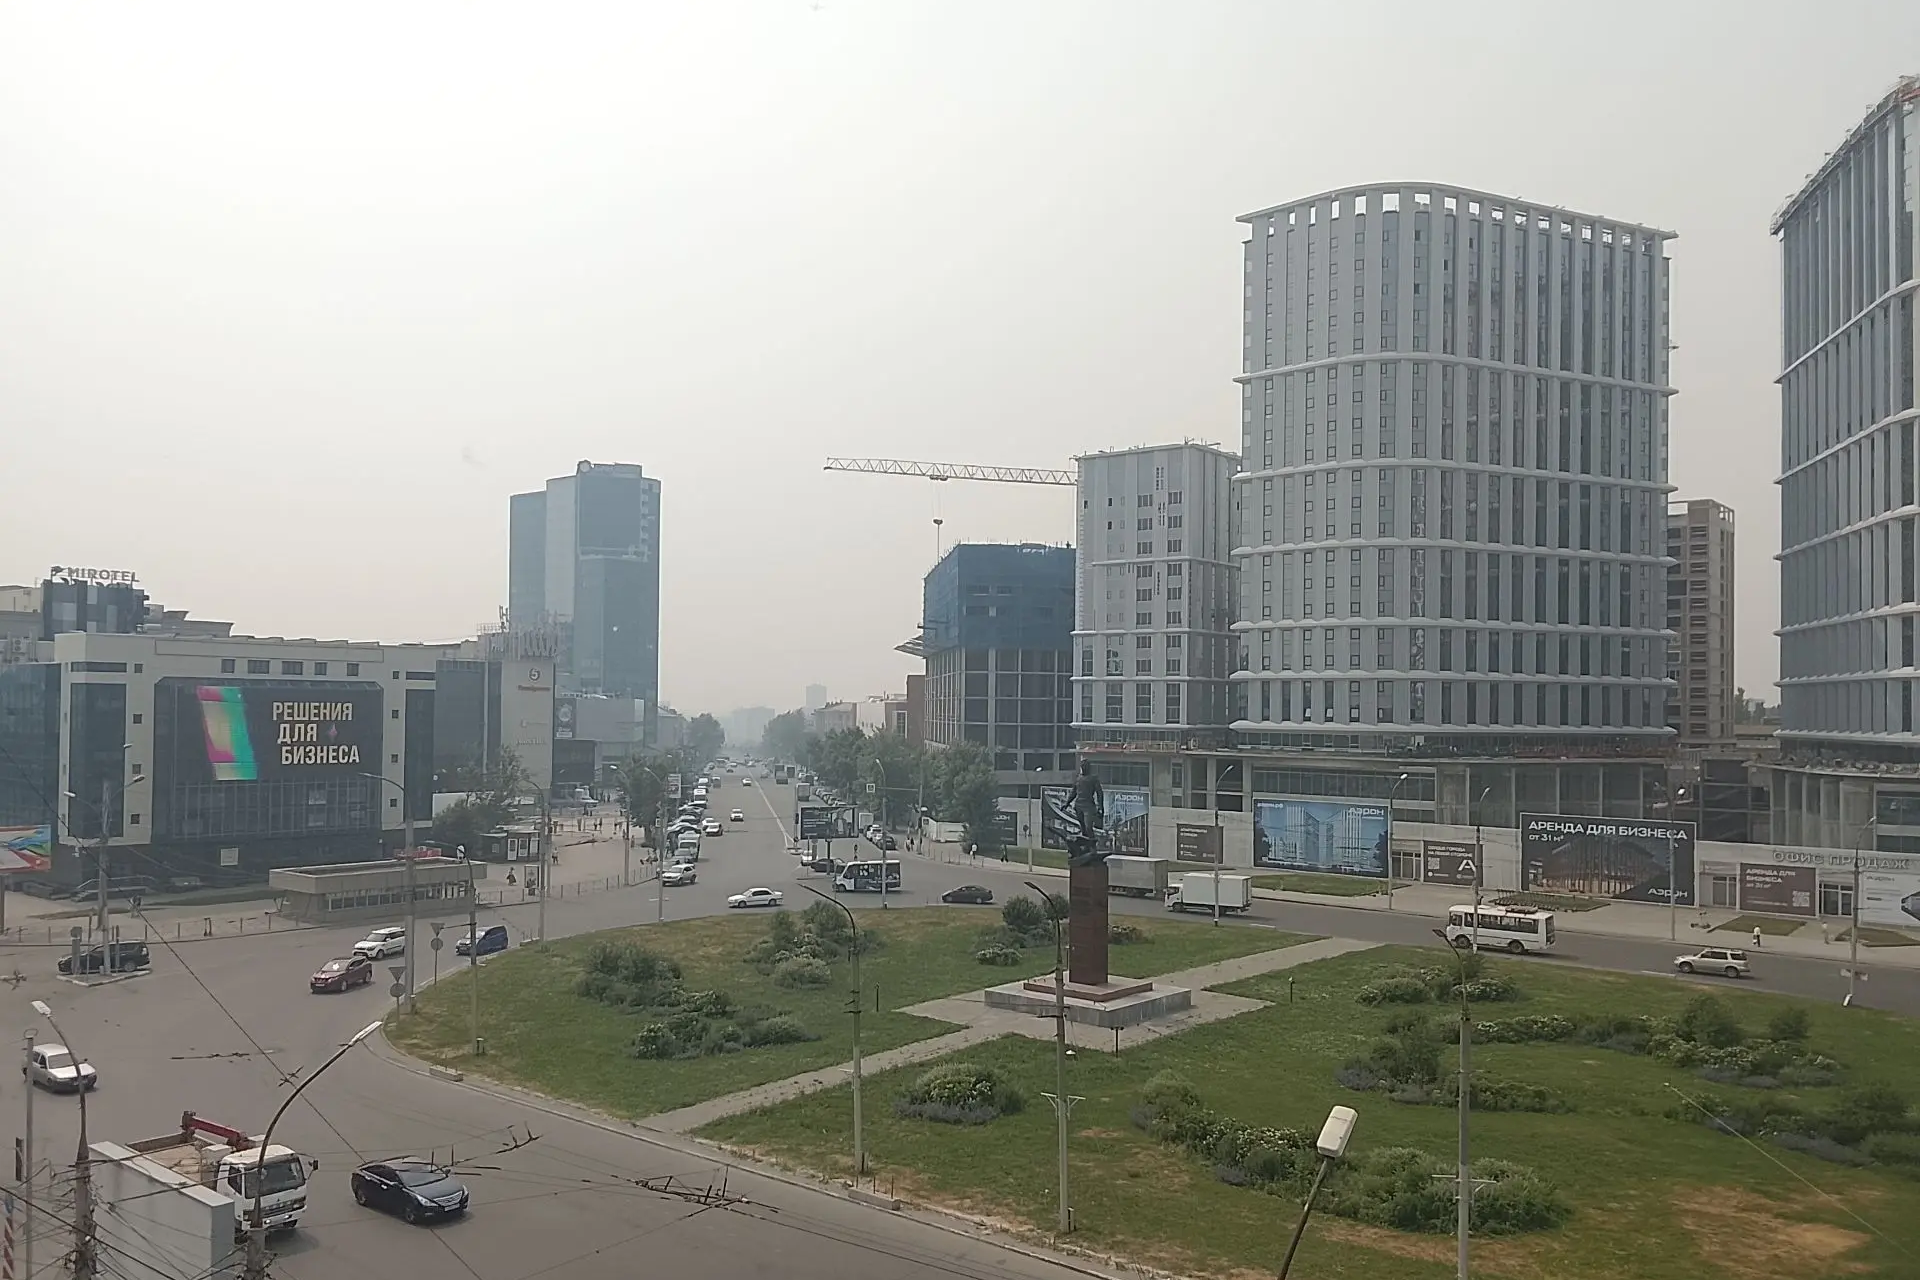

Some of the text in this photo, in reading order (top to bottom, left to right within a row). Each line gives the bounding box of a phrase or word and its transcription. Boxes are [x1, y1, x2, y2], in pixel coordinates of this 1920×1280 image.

[67, 567, 140, 582] MIROTEL
[273, 702, 353, 721] РЕШЕНИЯ
[277, 723, 317, 744] ДЛЯ
[281, 745, 360, 765] БИЗНЕСА
[1528, 821, 1688, 840] АРЕНДА ДЛЯ БИЗНЕСА
[1773, 851, 1908, 870] ОФИС ПРОДАЖ
